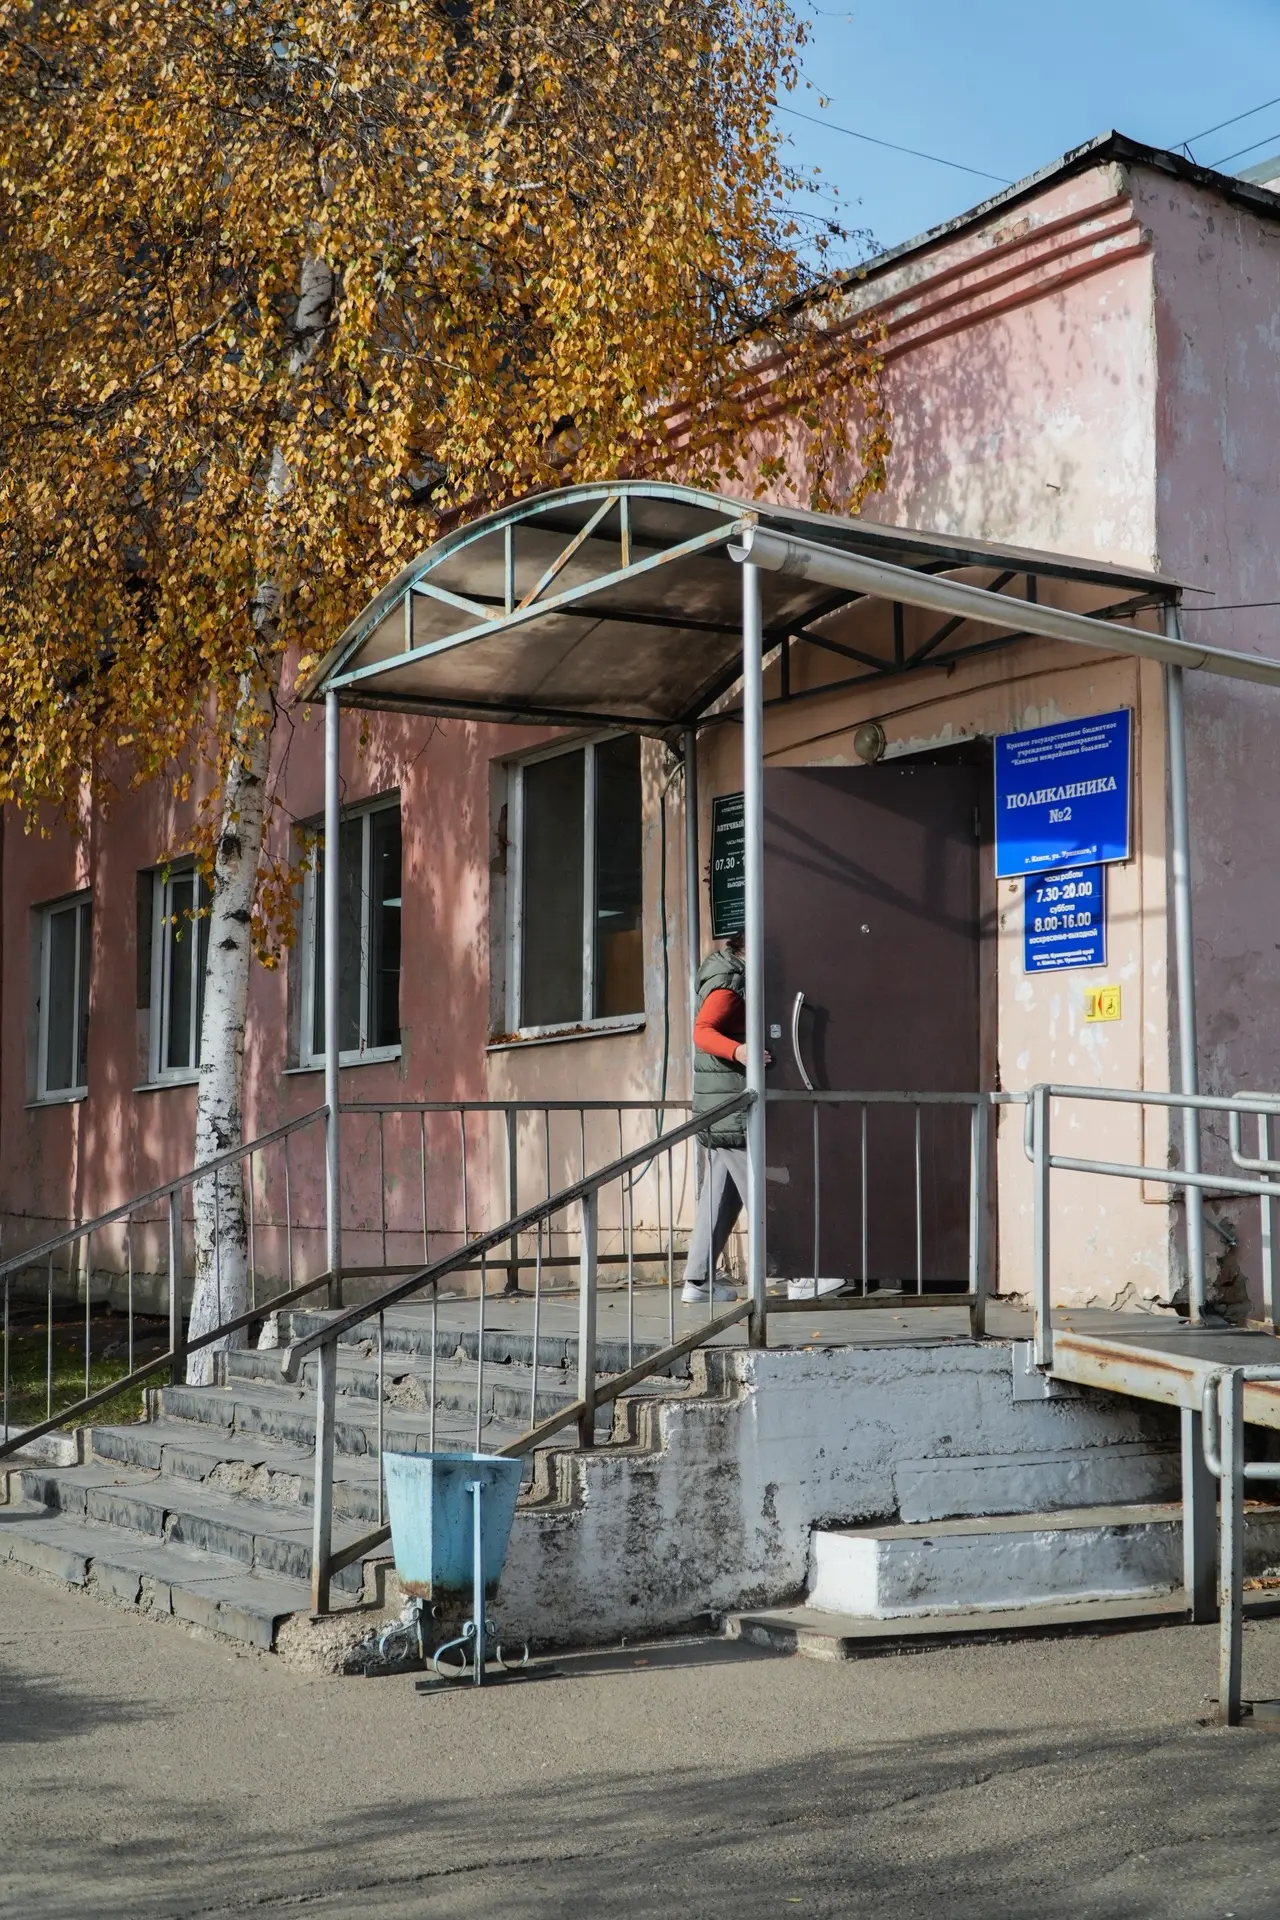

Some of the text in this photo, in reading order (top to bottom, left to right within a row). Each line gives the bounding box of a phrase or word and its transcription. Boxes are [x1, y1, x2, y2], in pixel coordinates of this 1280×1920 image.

[1031, 730, 1081, 746] государственное
[1082, 722, 1117, 734] бюджетное
[1017, 734, 1106, 757] учреждение здравоохранения
[1039, 747, 1080, 760] межрайонная
[1006, 776, 1118, 809] ПОЛИКЛИНИКА
[1049, 806, 1072, 824] №2
[715, 857, 735, 871] 07.30
[1036, 881, 1093, 903] 7.30-20.00
[1049, 903, 1076, 914] суббота
[1034, 911, 1092, 933] 8.00-16.00
